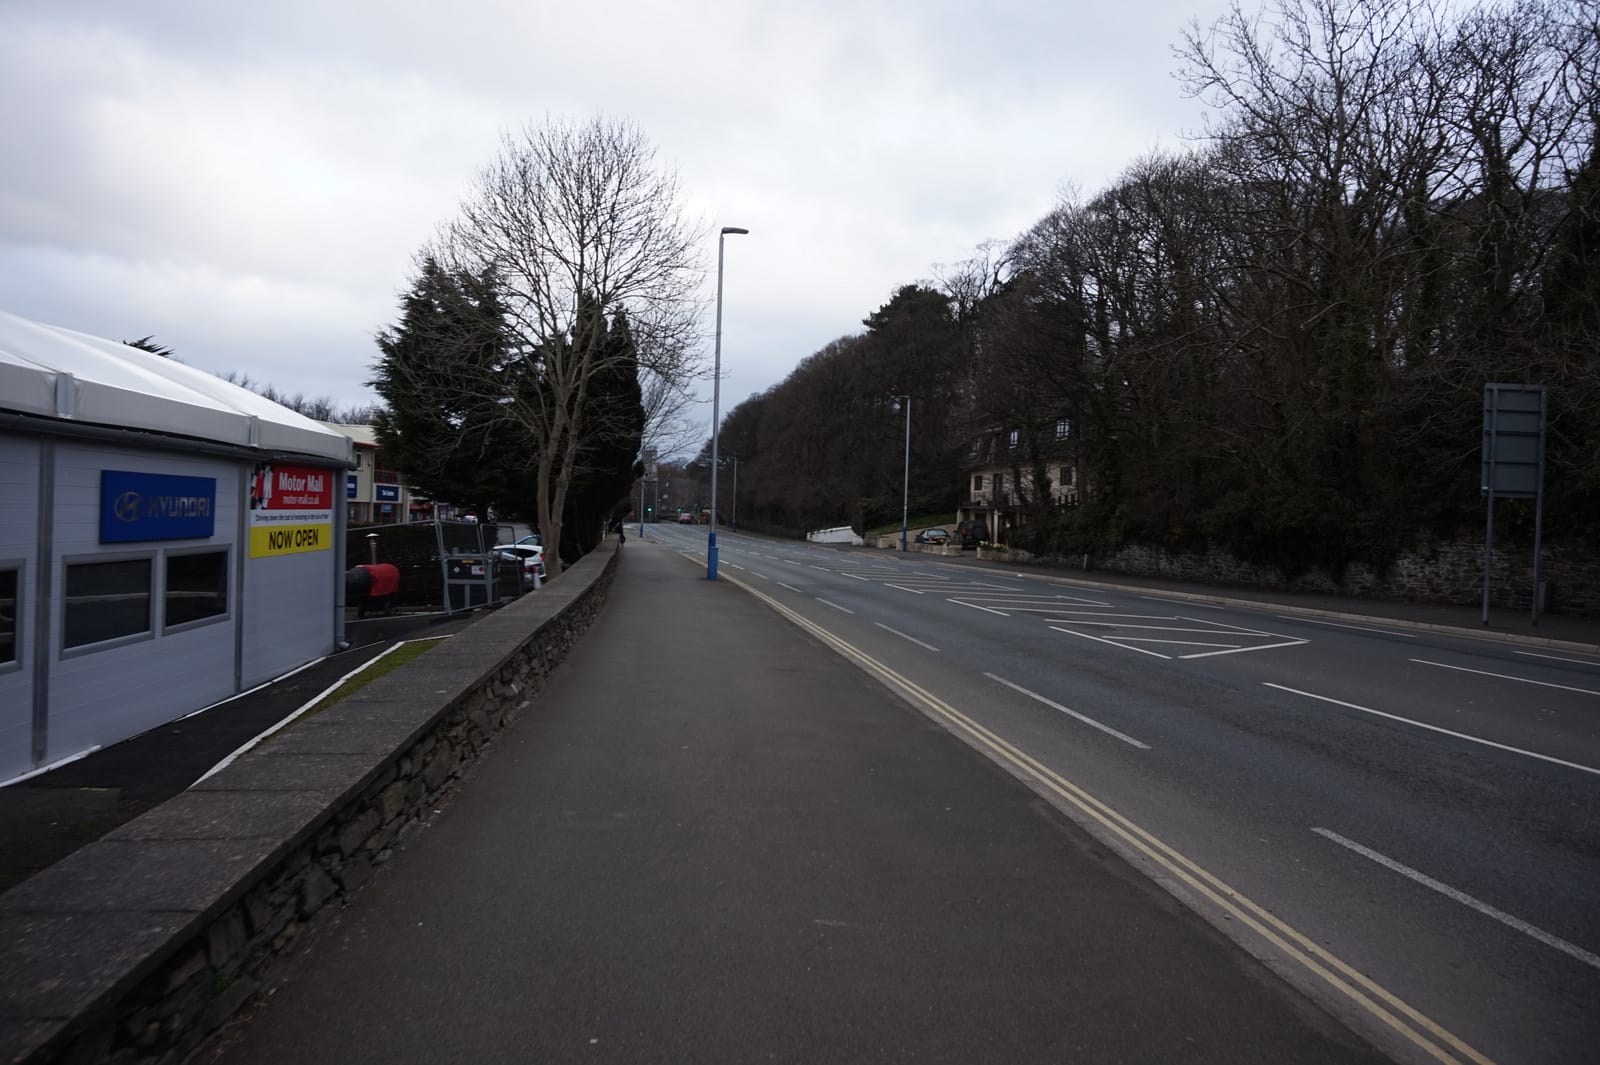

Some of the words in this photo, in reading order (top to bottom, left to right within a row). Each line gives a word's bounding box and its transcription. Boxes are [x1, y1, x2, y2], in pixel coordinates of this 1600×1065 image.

[278, 472, 306, 491] Motor
[307, 474, 323, 492] Mall
[147, 496, 211, 517] HYUNDAI
[268, 530, 293, 550] NOW
[295, 528, 319, 547] OPEN
